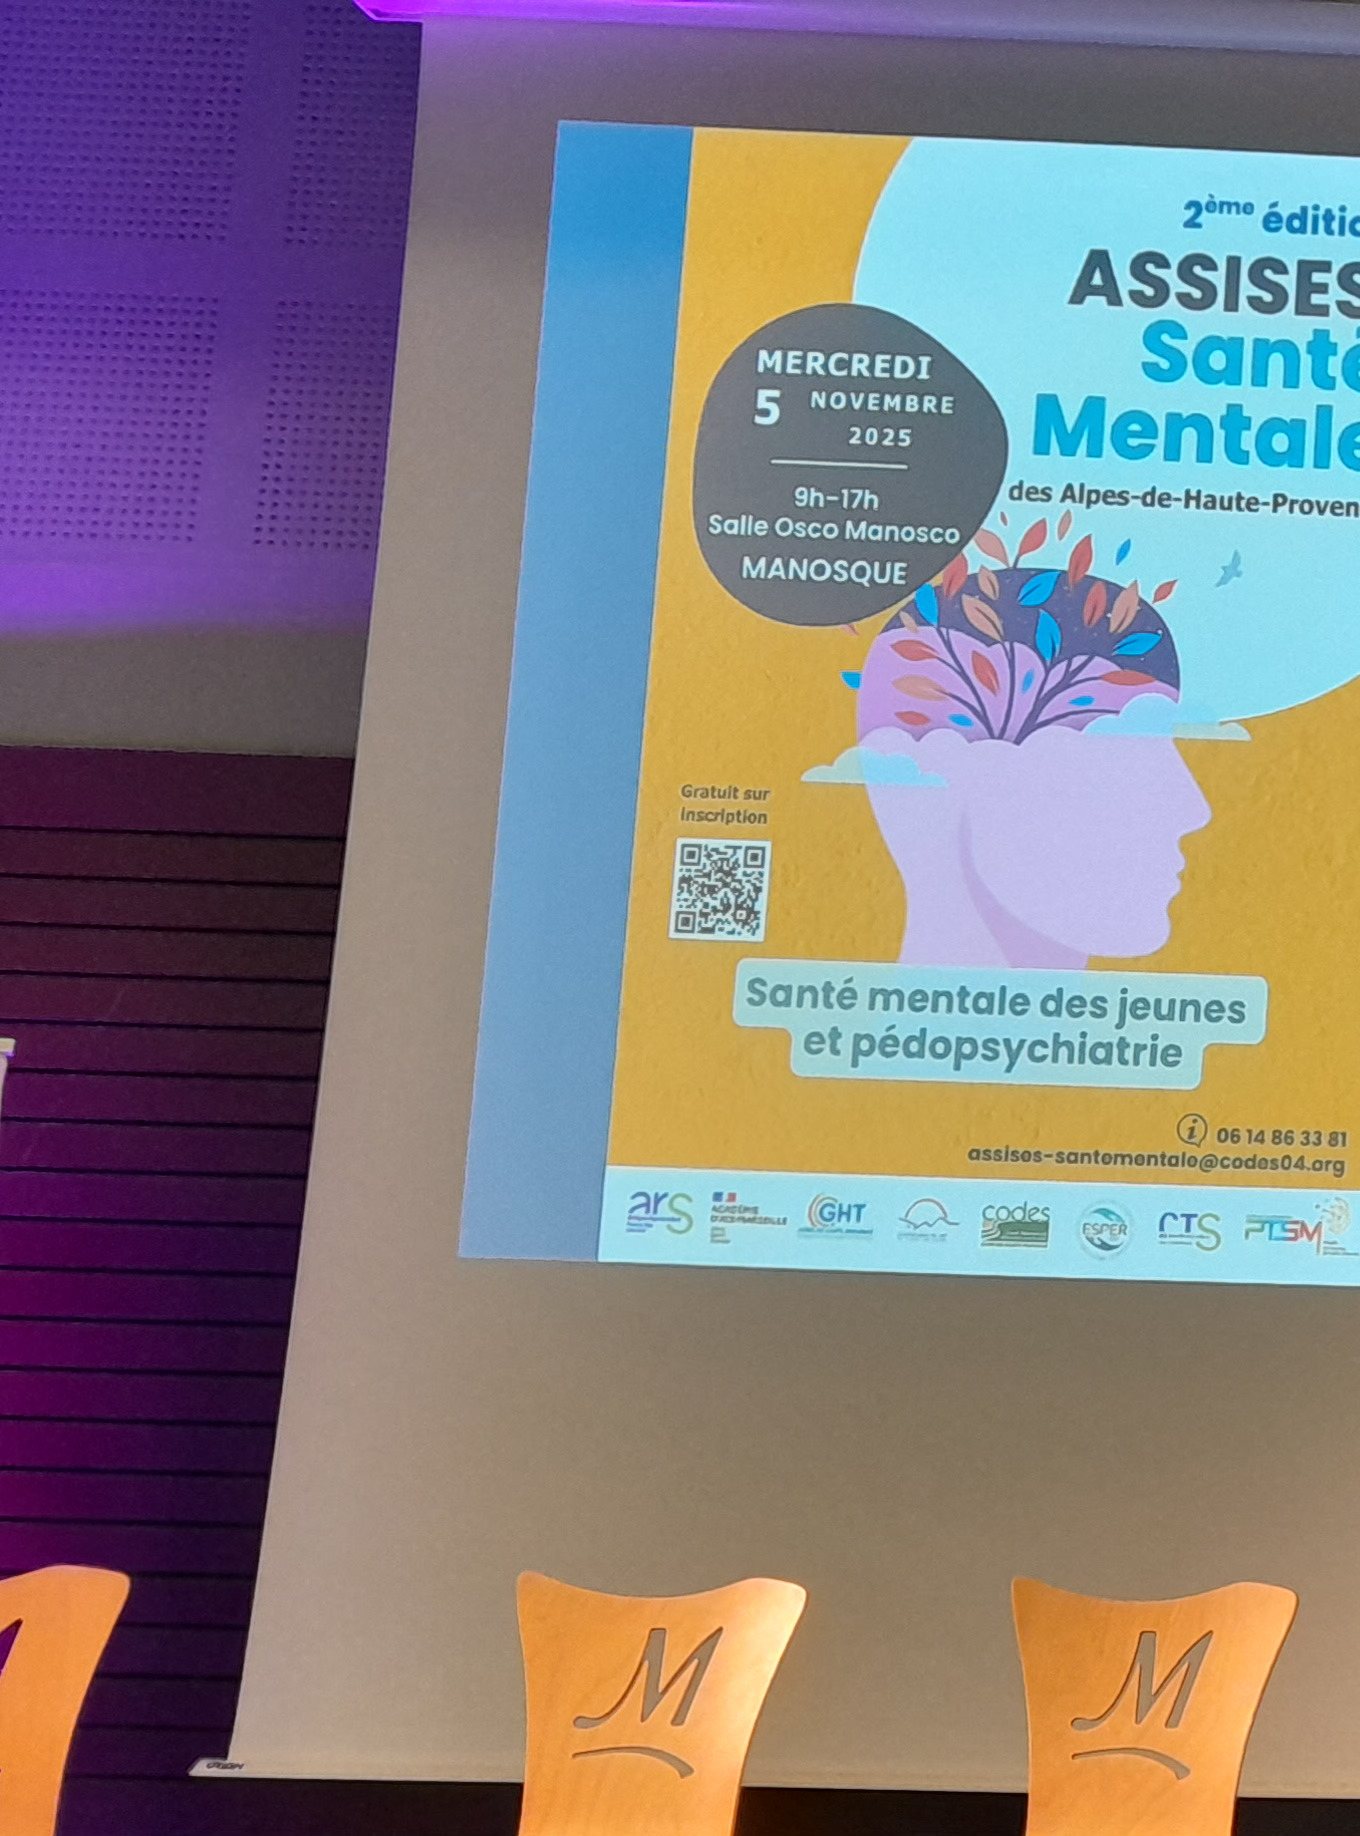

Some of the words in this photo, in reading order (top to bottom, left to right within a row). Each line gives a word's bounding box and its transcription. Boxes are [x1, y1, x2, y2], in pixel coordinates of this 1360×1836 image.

[1183, 195, 1254, 231] 2ème
[755, 349, 933, 382] MERCREDI
[753, 390, 782, 426] 5
[810, 391, 956, 415] NOVEMBRE
[848, 426, 913, 448] 2025
[793, 486, 880, 512] 9h-17h
[1009, 480, 1054, 507] des
[707, 513, 770, 540] Salle
[774, 515, 839, 542] Osco
[844, 518, 961, 546] Manosco
[740, 558, 908, 587] MANOSQUE
[680, 783, 740, 801] Gratuit
[742, 787, 770, 803] sur
[679, 807, 768, 828] inscription
[745, 975, 857, 1013] Santé
[867, 984, 1031, 1018] mentale
[1039, 989, 1109, 1021] des
[1115, 990, 1246, 1029] jeunes
[802, 1028, 842, 1057] et
[850, 1025, 1183, 1074] pédopsychiatrie
[1216, 1128, 1240, 1144] 06
[1246, 1129, 1265, 1145] 14
[1271, 1130, 1295, 1145] 86
[1299, 1131, 1323, 1146] 33
[1328, 1132, 1348, 1147] 81
[818, 1203, 866, 1224] GHT
[981, 1202, 1050, 1223] codes
[1082, 1222, 1128, 1237] ESPER
